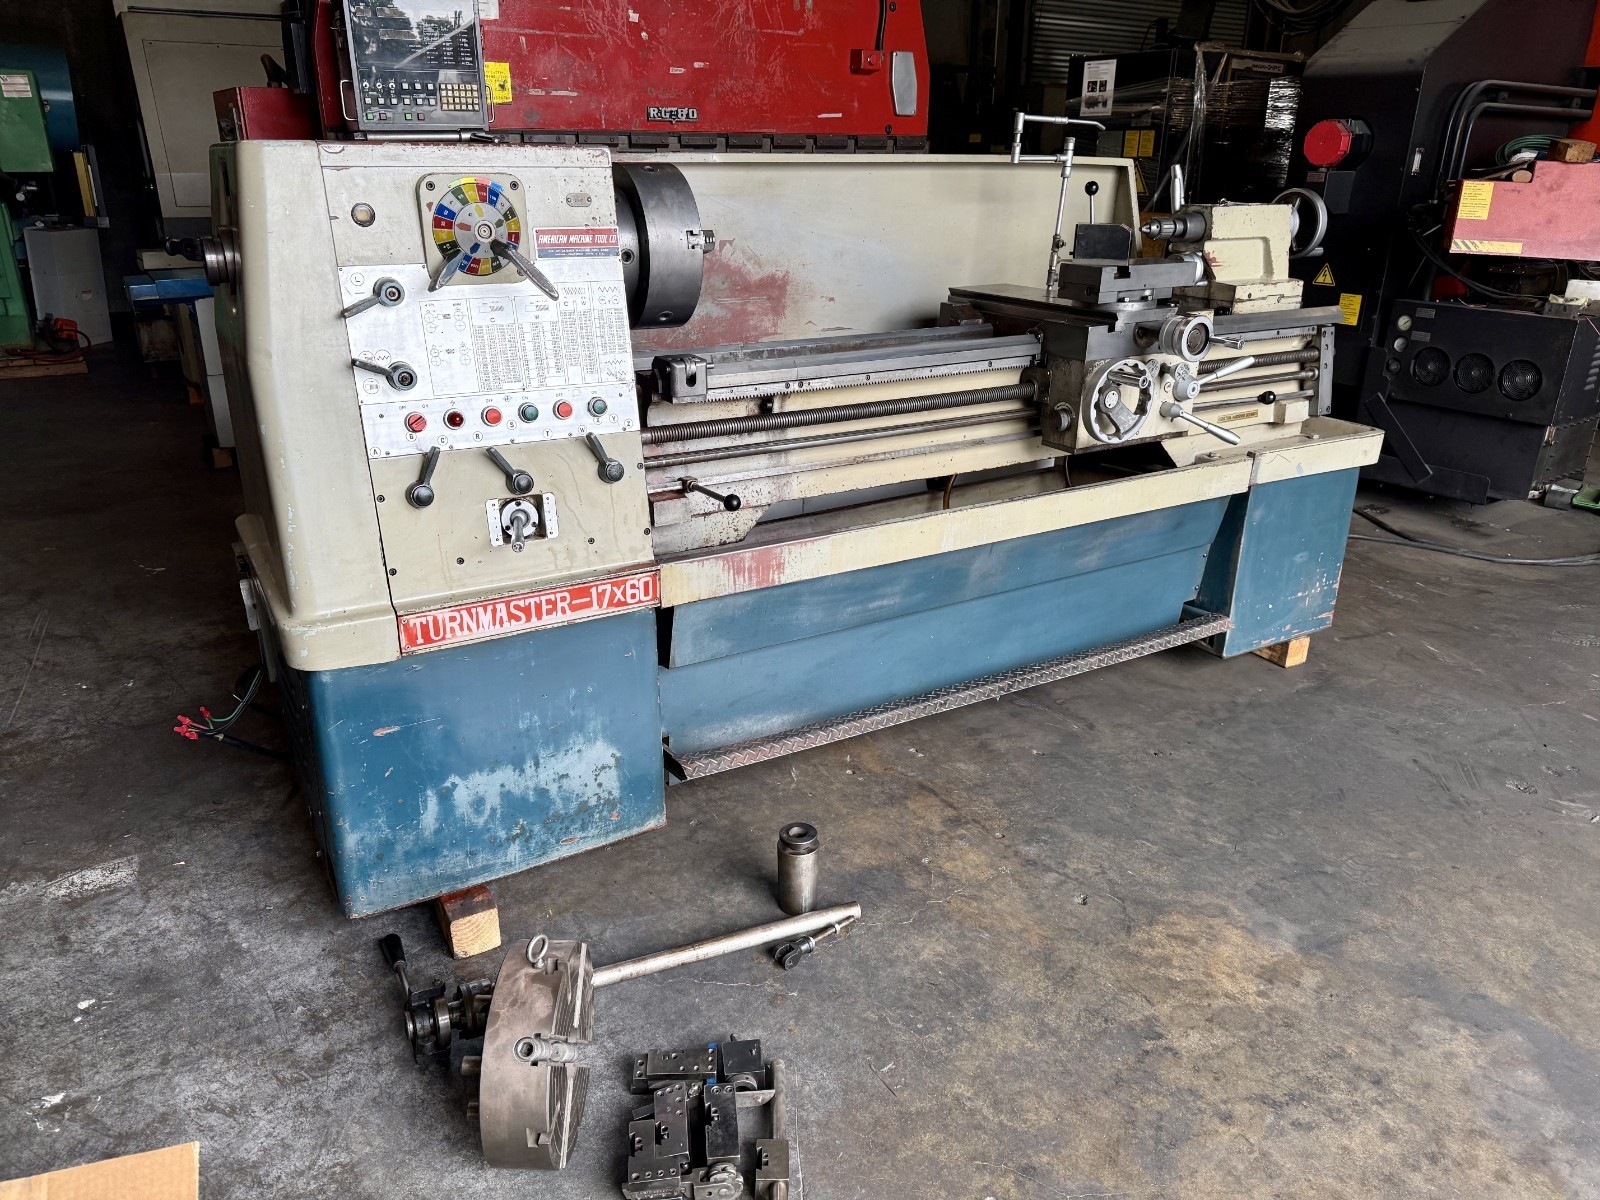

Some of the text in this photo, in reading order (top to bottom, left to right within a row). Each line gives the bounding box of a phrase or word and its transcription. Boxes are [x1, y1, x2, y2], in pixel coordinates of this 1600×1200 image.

[538, 234, 568, 244] AMERICAN
[568, 234, 593, 244] MACHINE
[594, 234, 608, 244] TOOL
